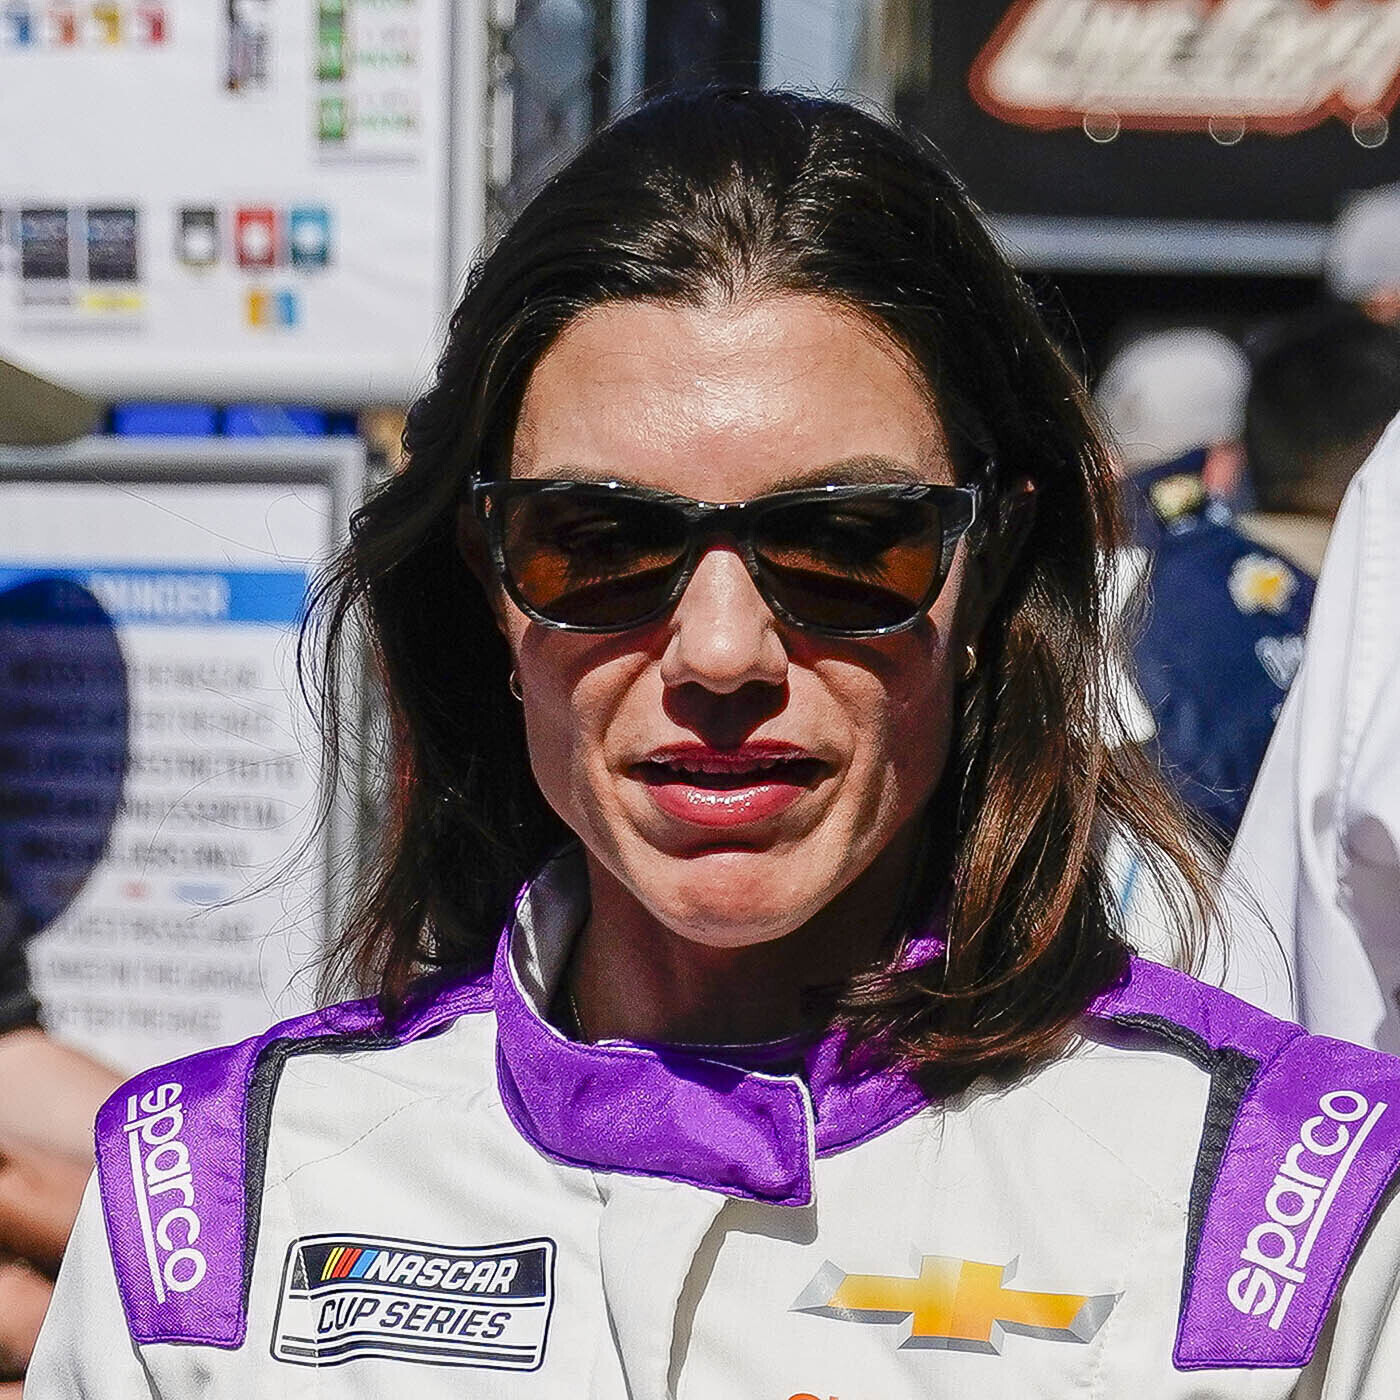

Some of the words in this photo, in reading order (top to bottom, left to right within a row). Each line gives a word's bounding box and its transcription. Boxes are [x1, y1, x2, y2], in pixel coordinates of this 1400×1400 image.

[123, 1083, 207, 1293] sparco
[1228, 1090, 1370, 1318] sparco
[318, 1299, 381, 1334] CUP
[380, 1301, 512, 1339] SERIES
[363, 1249, 520, 1294] NASCAR
